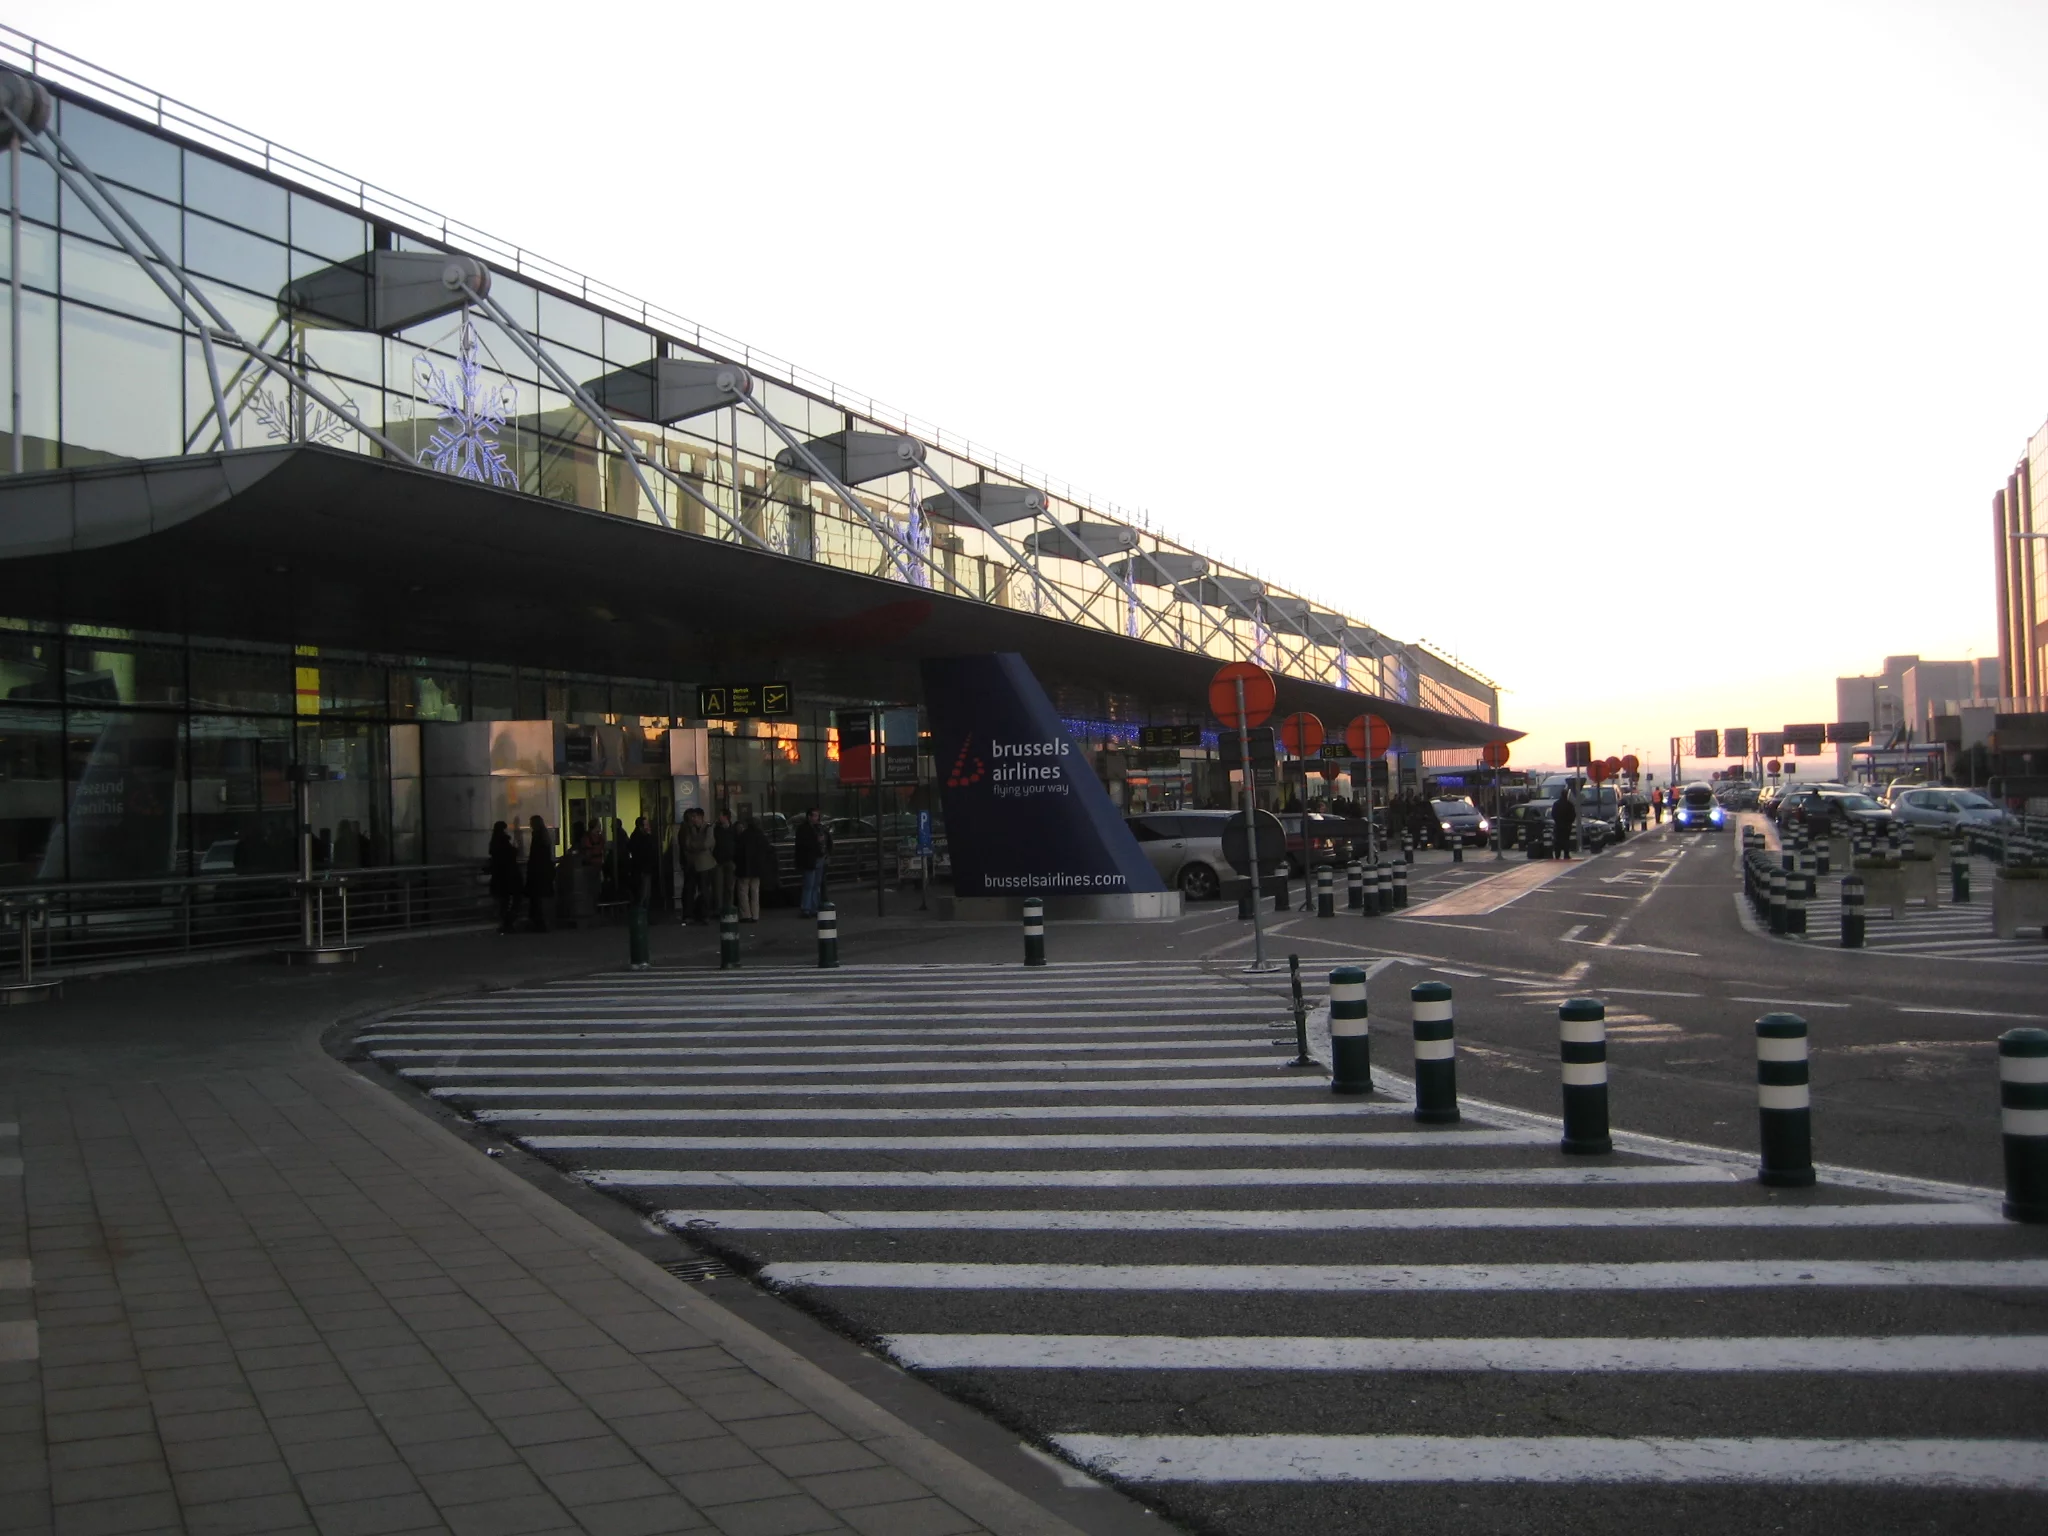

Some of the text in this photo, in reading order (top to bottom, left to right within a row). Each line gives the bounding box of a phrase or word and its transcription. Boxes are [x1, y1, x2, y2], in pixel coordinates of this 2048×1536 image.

[707, 693, 721, 711] A
[992, 738, 1070, 758] brussels
[888, 756, 914, 764] Brussels
[888, 764, 910, 772] Airport
[992, 762, 1061, 782] airlines
[993, 783, 1069, 797] flying your way
[920, 812, 928, 830] P
[984, 872, 1126, 888] brusselsairlines.com
